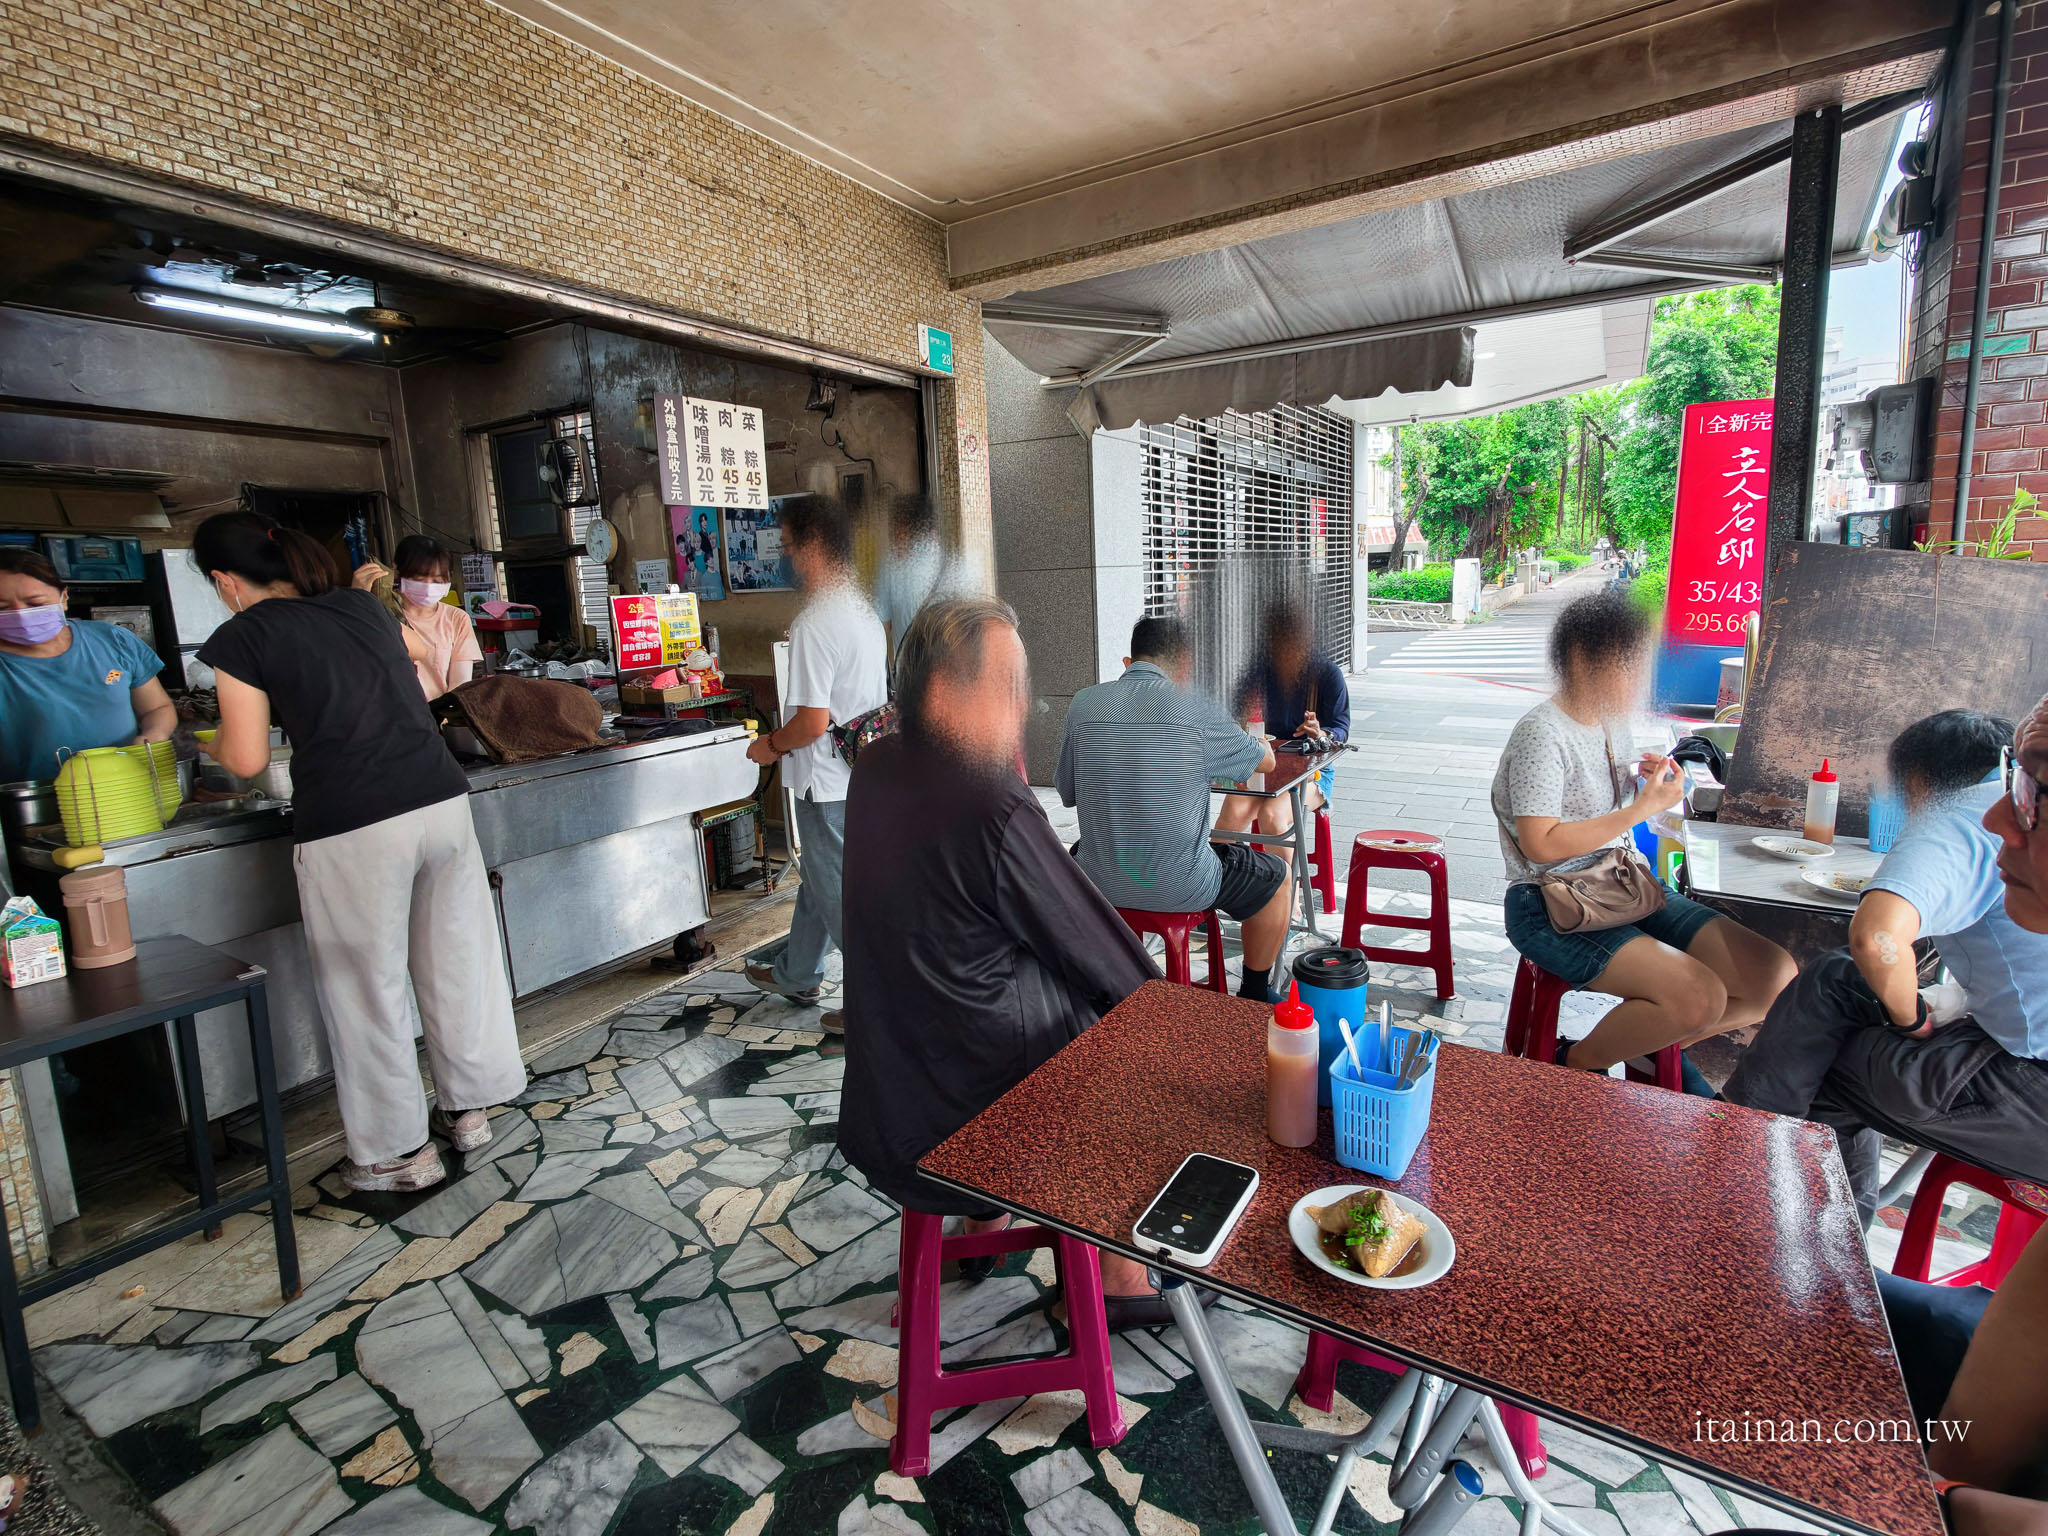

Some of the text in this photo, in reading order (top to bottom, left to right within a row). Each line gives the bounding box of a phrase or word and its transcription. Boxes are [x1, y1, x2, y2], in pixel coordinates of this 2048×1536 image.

[664, 399, 683, 501] 外帶盒加收2元
[693, 405, 715, 503] 味噌湯20元
[718, 409, 739, 504] 肉粽45元
[742, 412, 762, 505] 菜粽45元
[1706, 412, 1772, 434] 全新完
[1715, 446, 1766, 570] 立人名邸
[1688, 581, 1762, 603] 35/43
